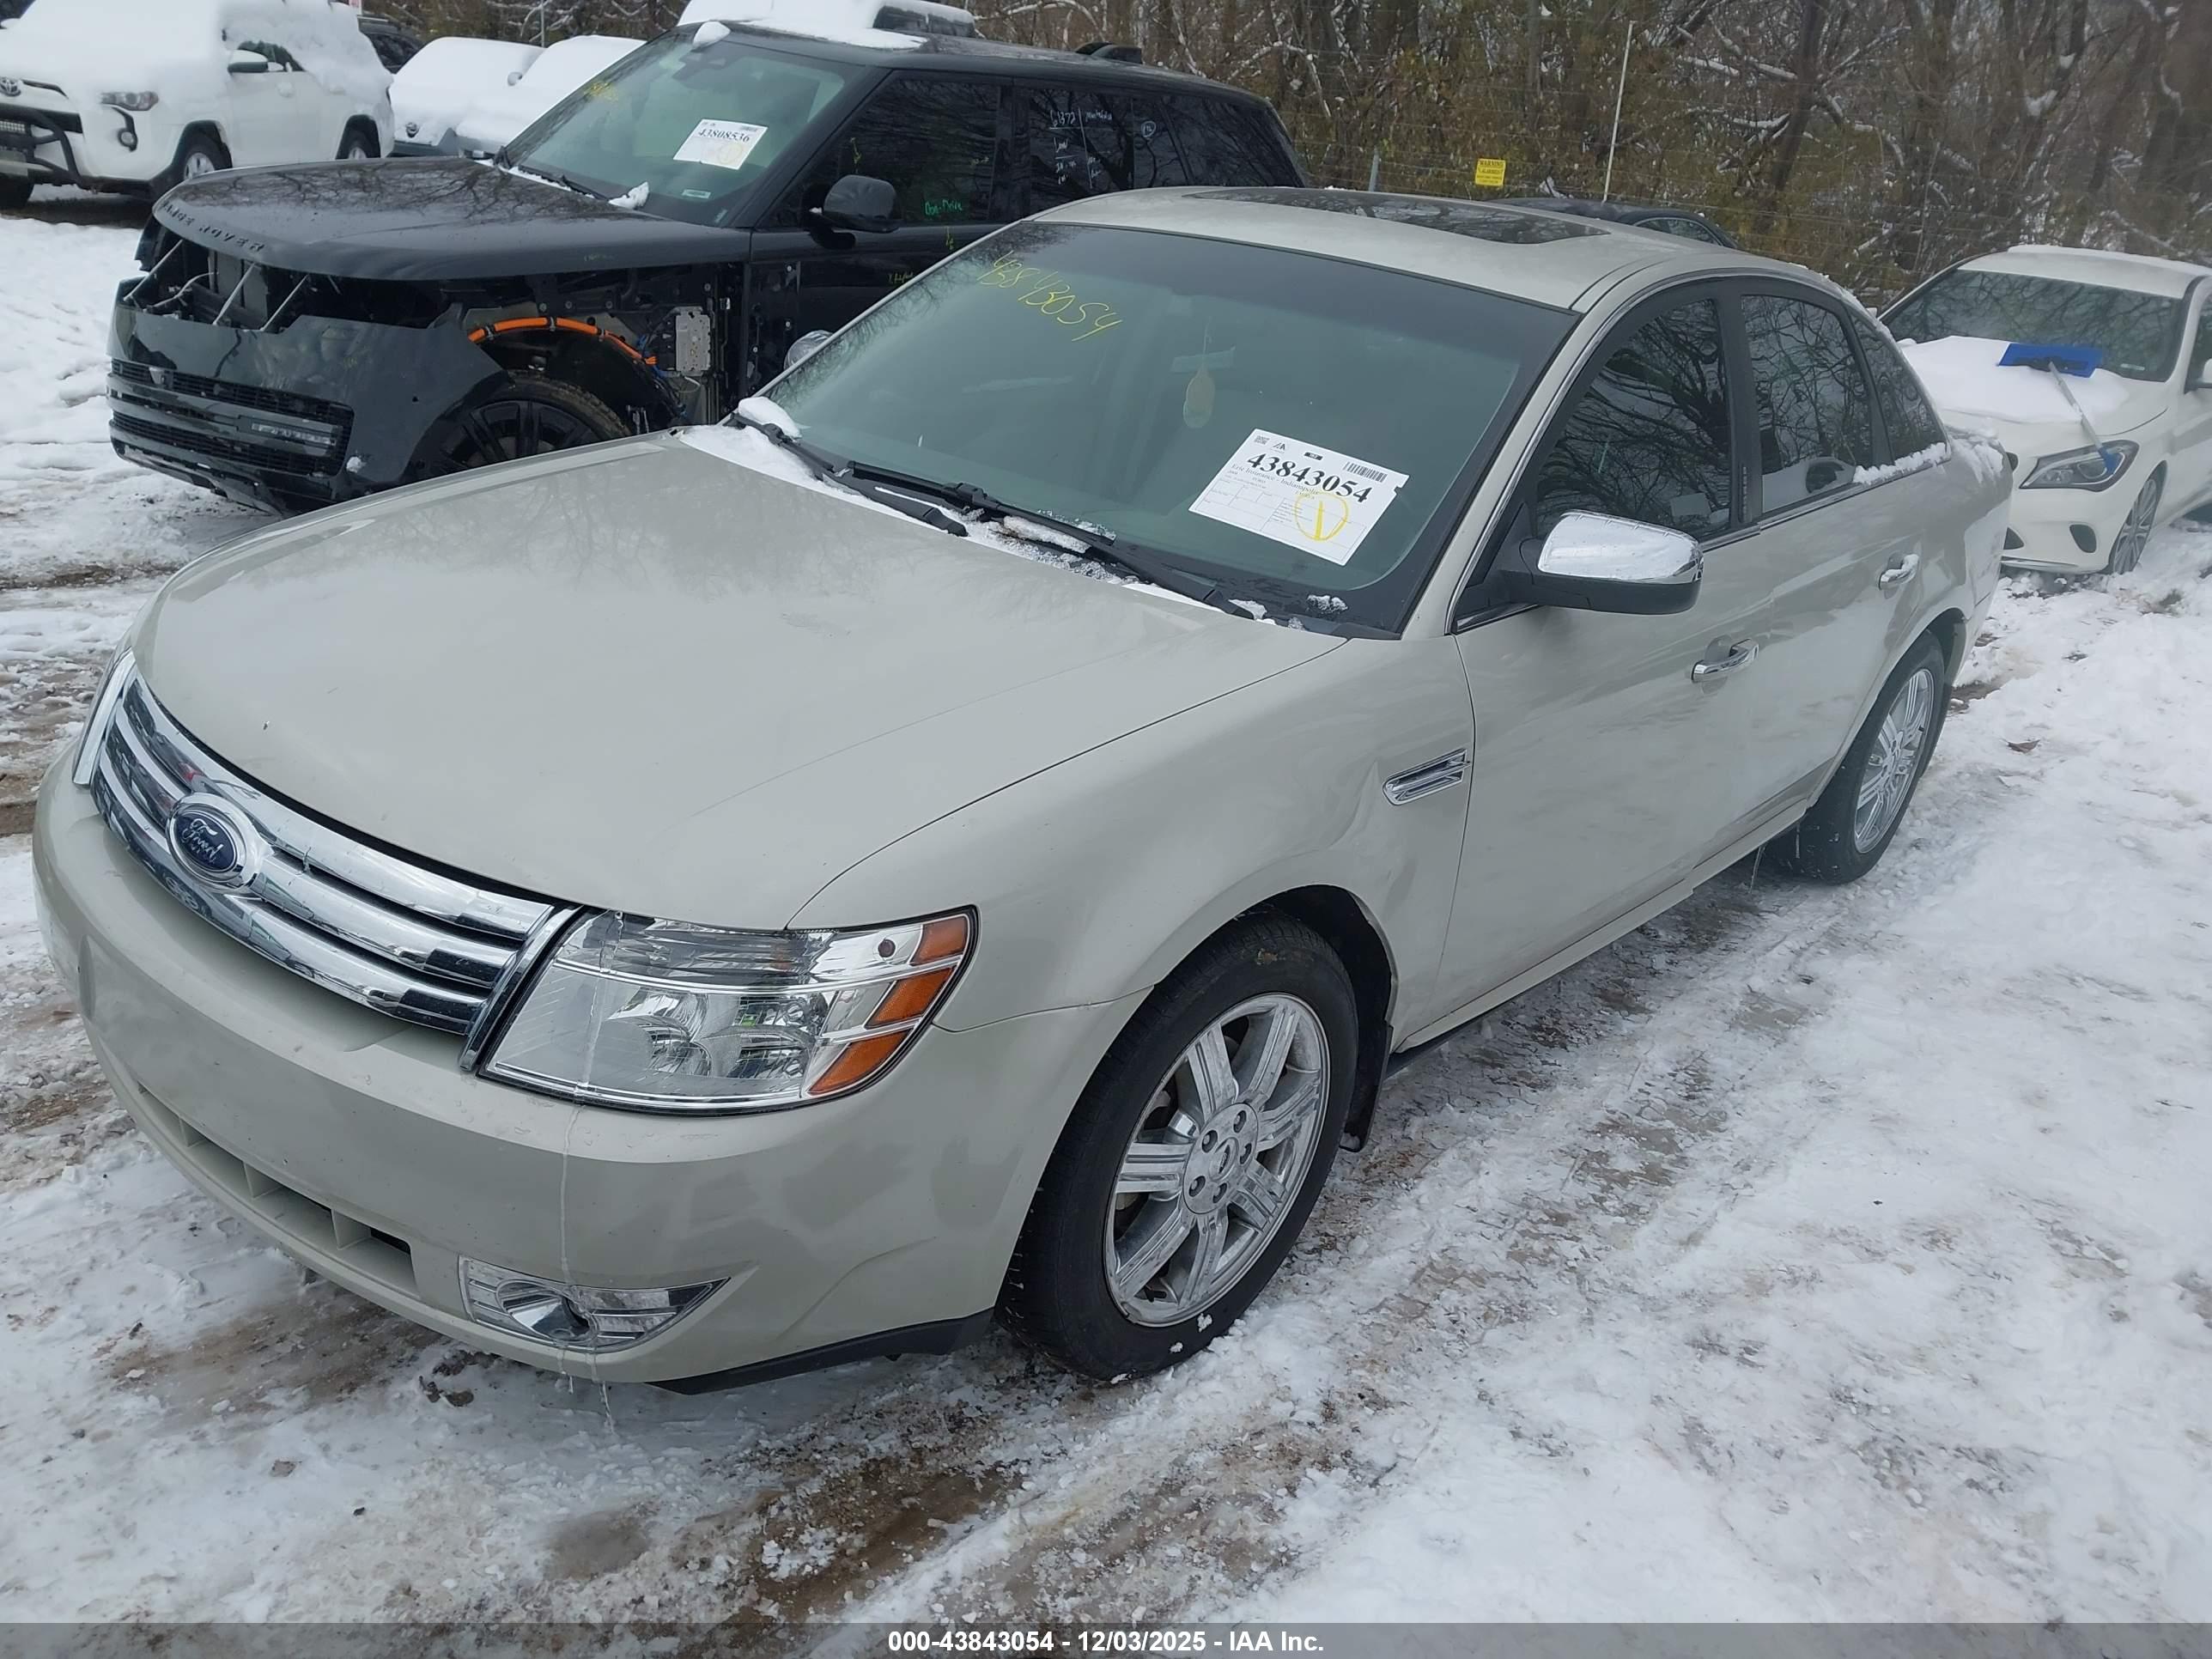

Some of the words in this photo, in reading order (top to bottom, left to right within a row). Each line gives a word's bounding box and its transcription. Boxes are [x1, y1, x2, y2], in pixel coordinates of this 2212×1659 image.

[198, 226, 265, 252] ROVER
[976, 250, 1123, 341] 43843054
[1245, 466, 1275, 481] Insurance
[1279, 478, 1319, 495] Indianapolis
[1247, 453, 1373, 503] 43843054
[181, 817, 224, 862] Ford
